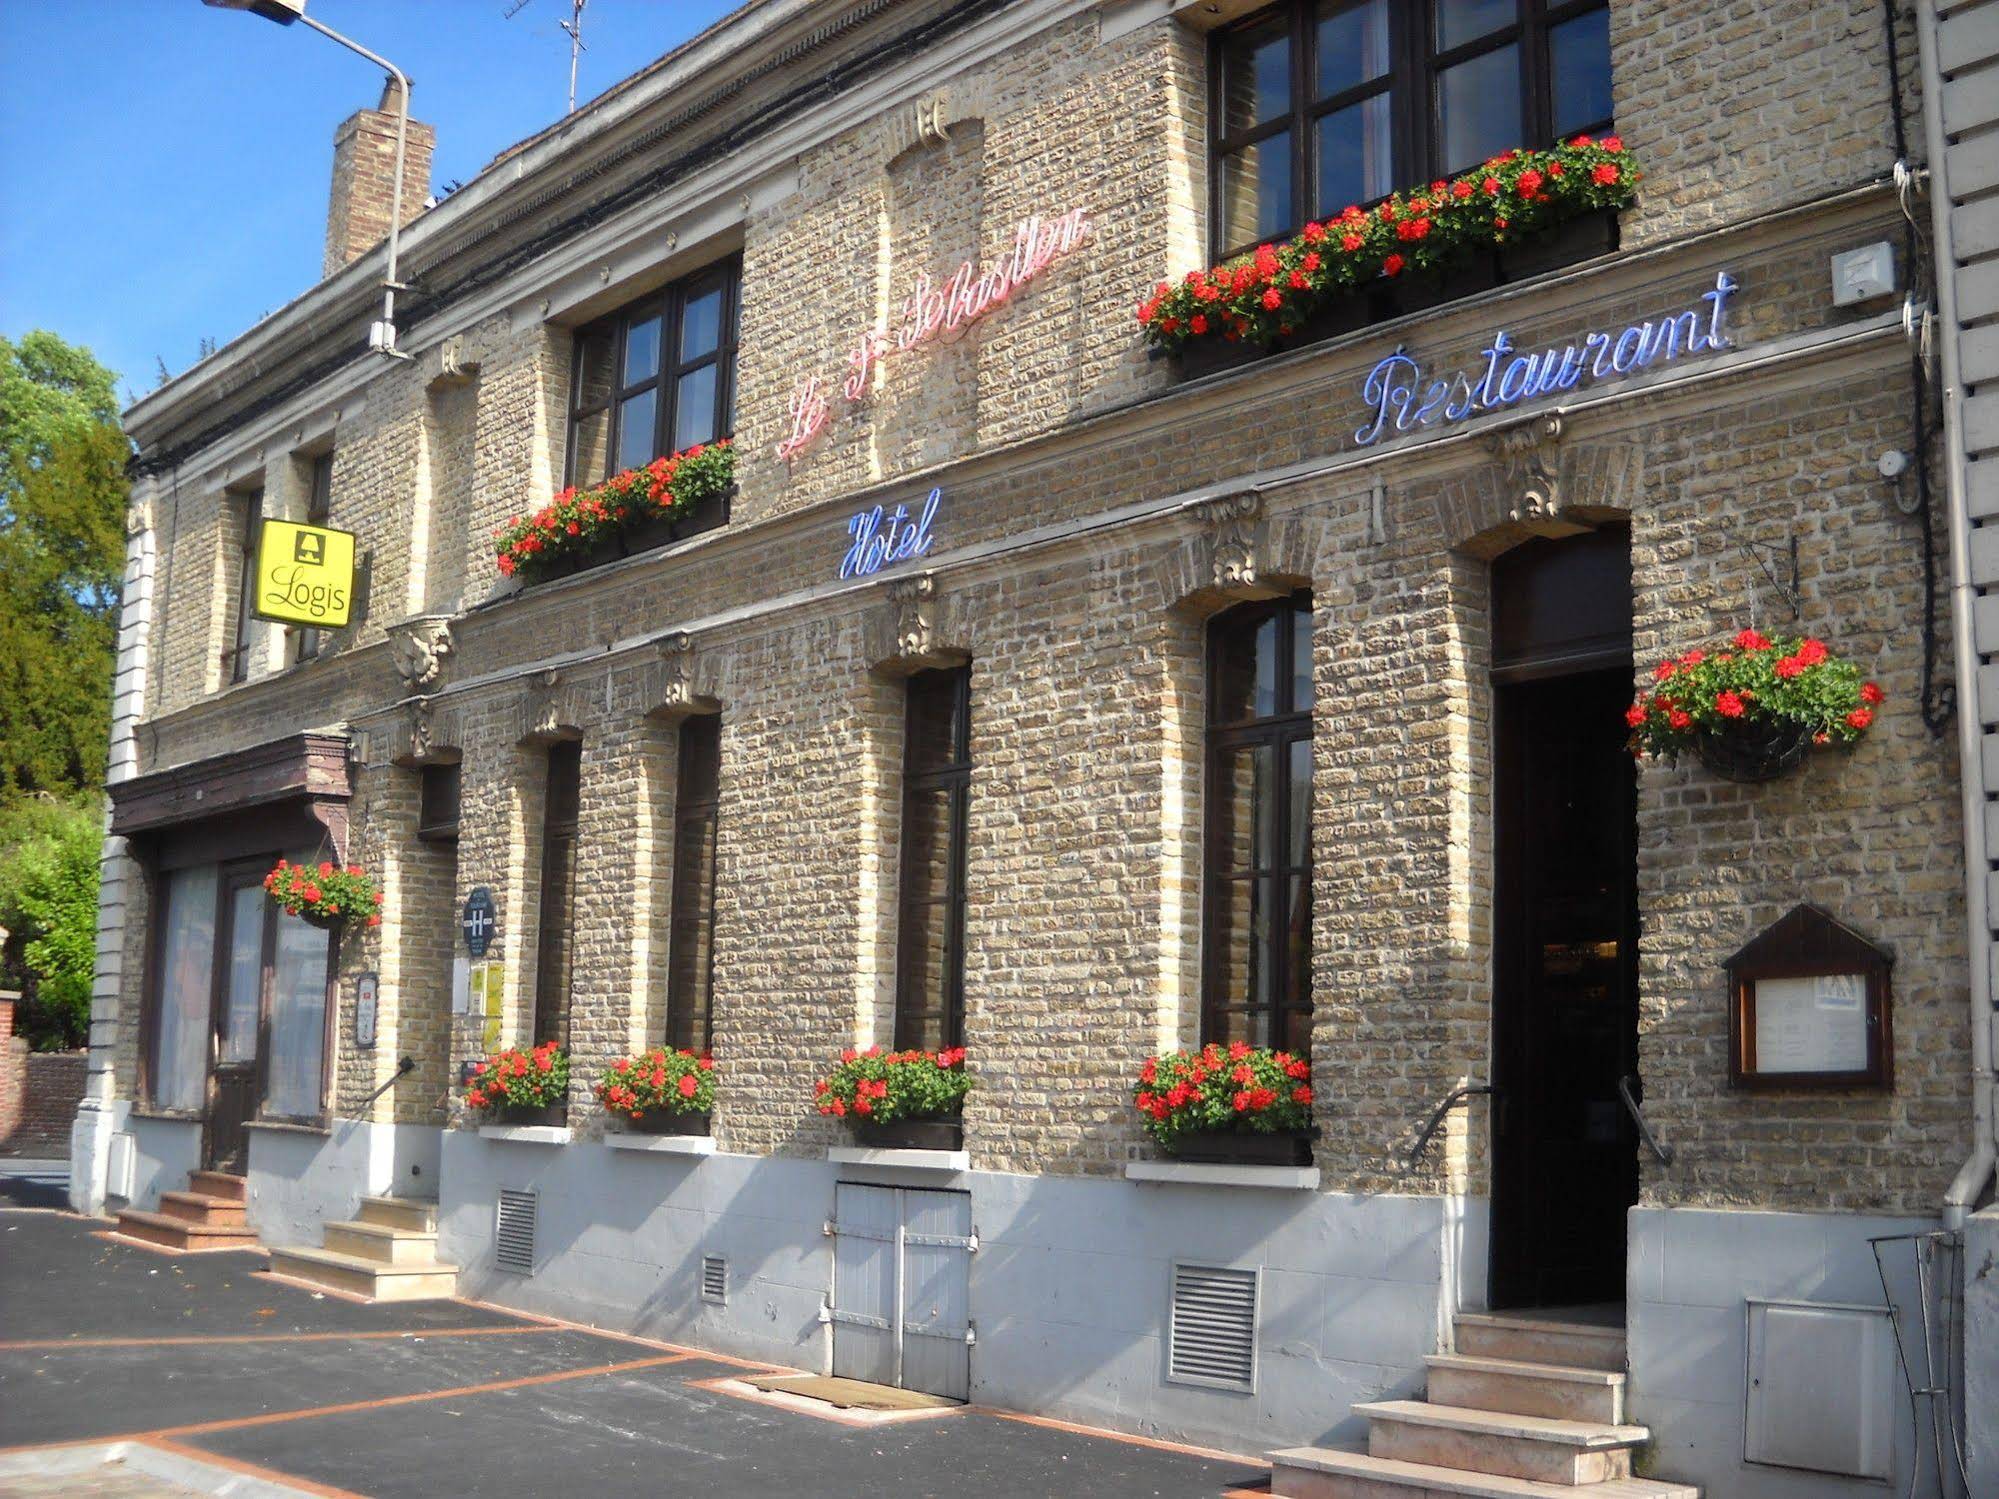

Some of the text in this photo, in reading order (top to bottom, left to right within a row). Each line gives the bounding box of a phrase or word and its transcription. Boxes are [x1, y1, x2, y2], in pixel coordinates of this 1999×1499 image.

[1354, 271, 1738, 446] Restaurant
[776, 376, 828, 459] Le
[265, 564, 345, 617] Logis
